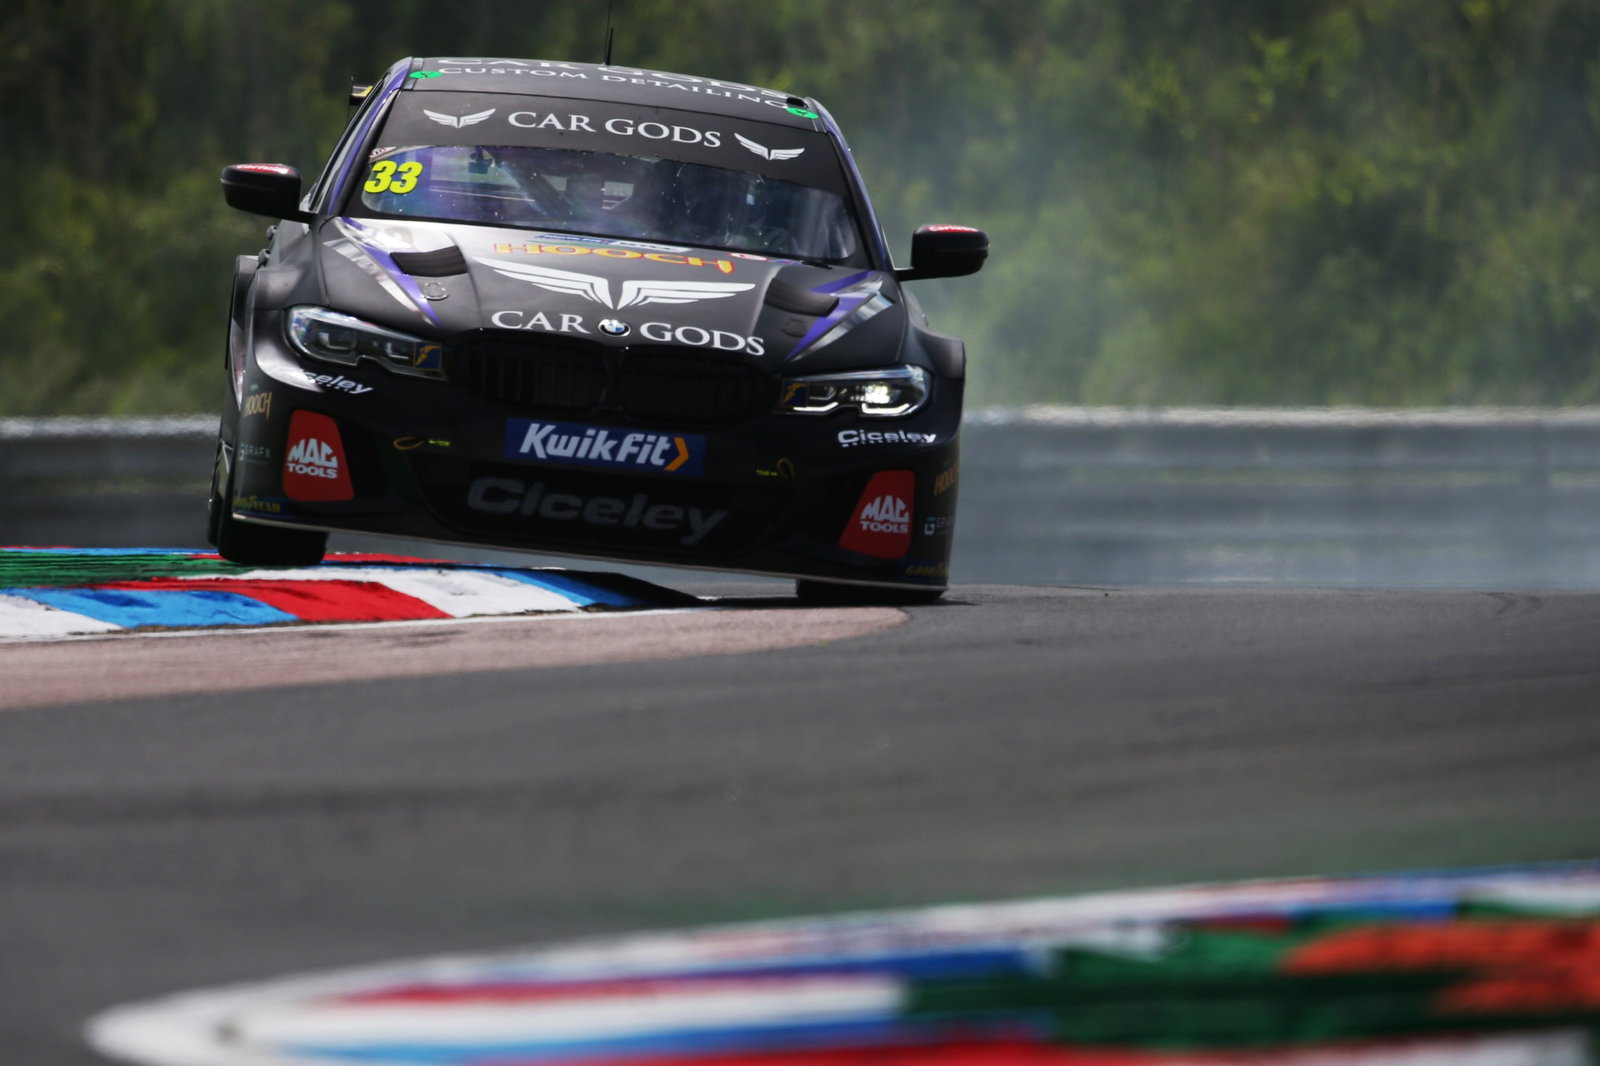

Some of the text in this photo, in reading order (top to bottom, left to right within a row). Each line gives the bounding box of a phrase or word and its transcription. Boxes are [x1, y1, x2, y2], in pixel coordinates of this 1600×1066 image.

[438, 68, 788, 109] CUSTOM DETAILING
[508, 111, 721, 147] CAR GODS
[363, 160, 423, 194] 33
[494, 243, 735, 274] HOOCH
[491, 311, 765, 356] CAR GODS
[243, 391, 272, 421] HOOCH
[838, 429, 936, 445] Ciceley
[288, 438, 337, 468] MAC
[288, 463, 337, 479] TOOLS
[860, 496, 909, 522] MAC
[860, 520, 908, 534] TOOLS
